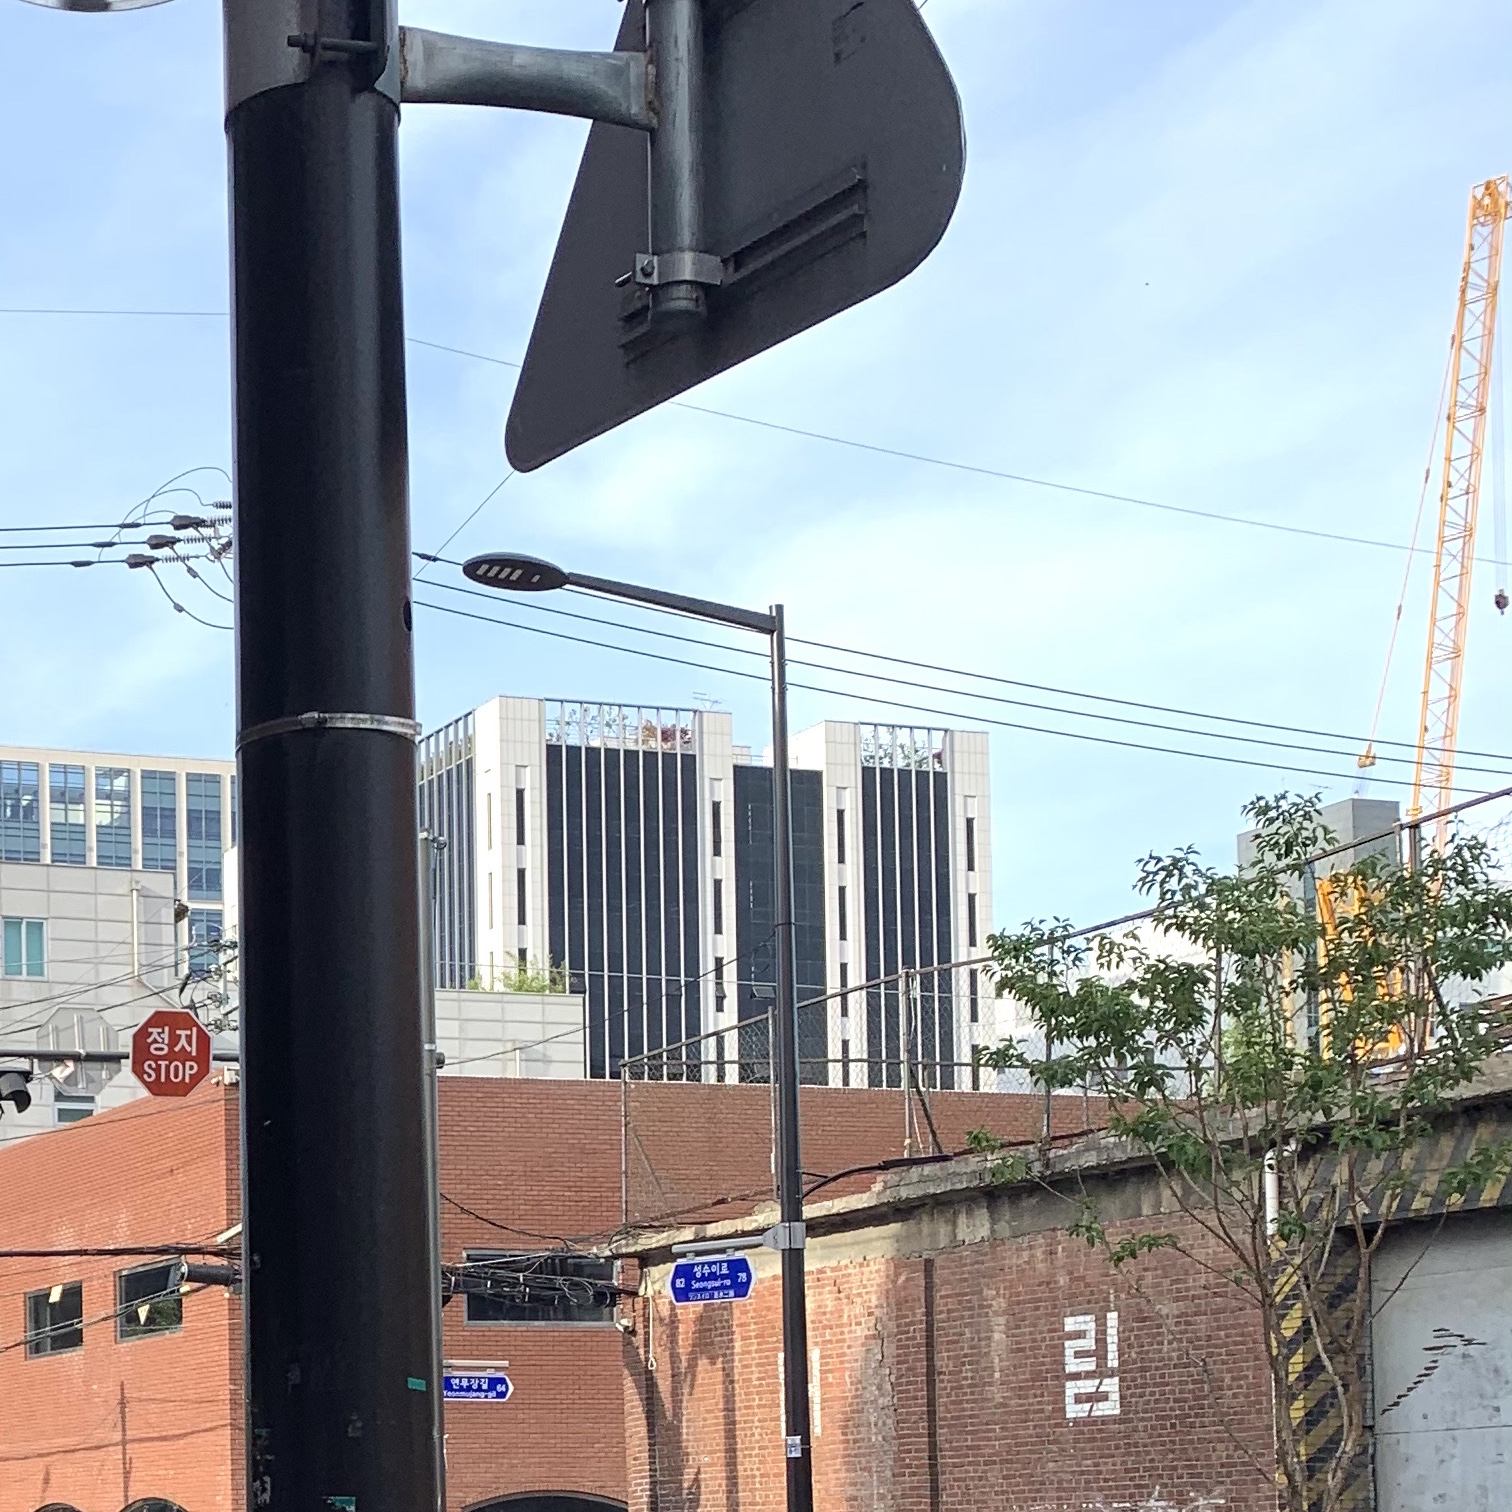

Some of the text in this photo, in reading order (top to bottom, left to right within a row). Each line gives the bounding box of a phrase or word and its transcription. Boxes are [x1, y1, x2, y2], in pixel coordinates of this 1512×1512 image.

[146, 1026, 197, 1056] 정지
[143, 1060, 198, 1083] STOP
[693, 1263, 729, 1278] 성수이로
[737, 1272, 747, 1282] 78
[675, 1278, 685, 1288] 82
[691, 1279, 731, 1289] Seongsui-ro
[450, 1378, 489, 1390] 연무장길
[496, 1384, 506, 1392] 64
